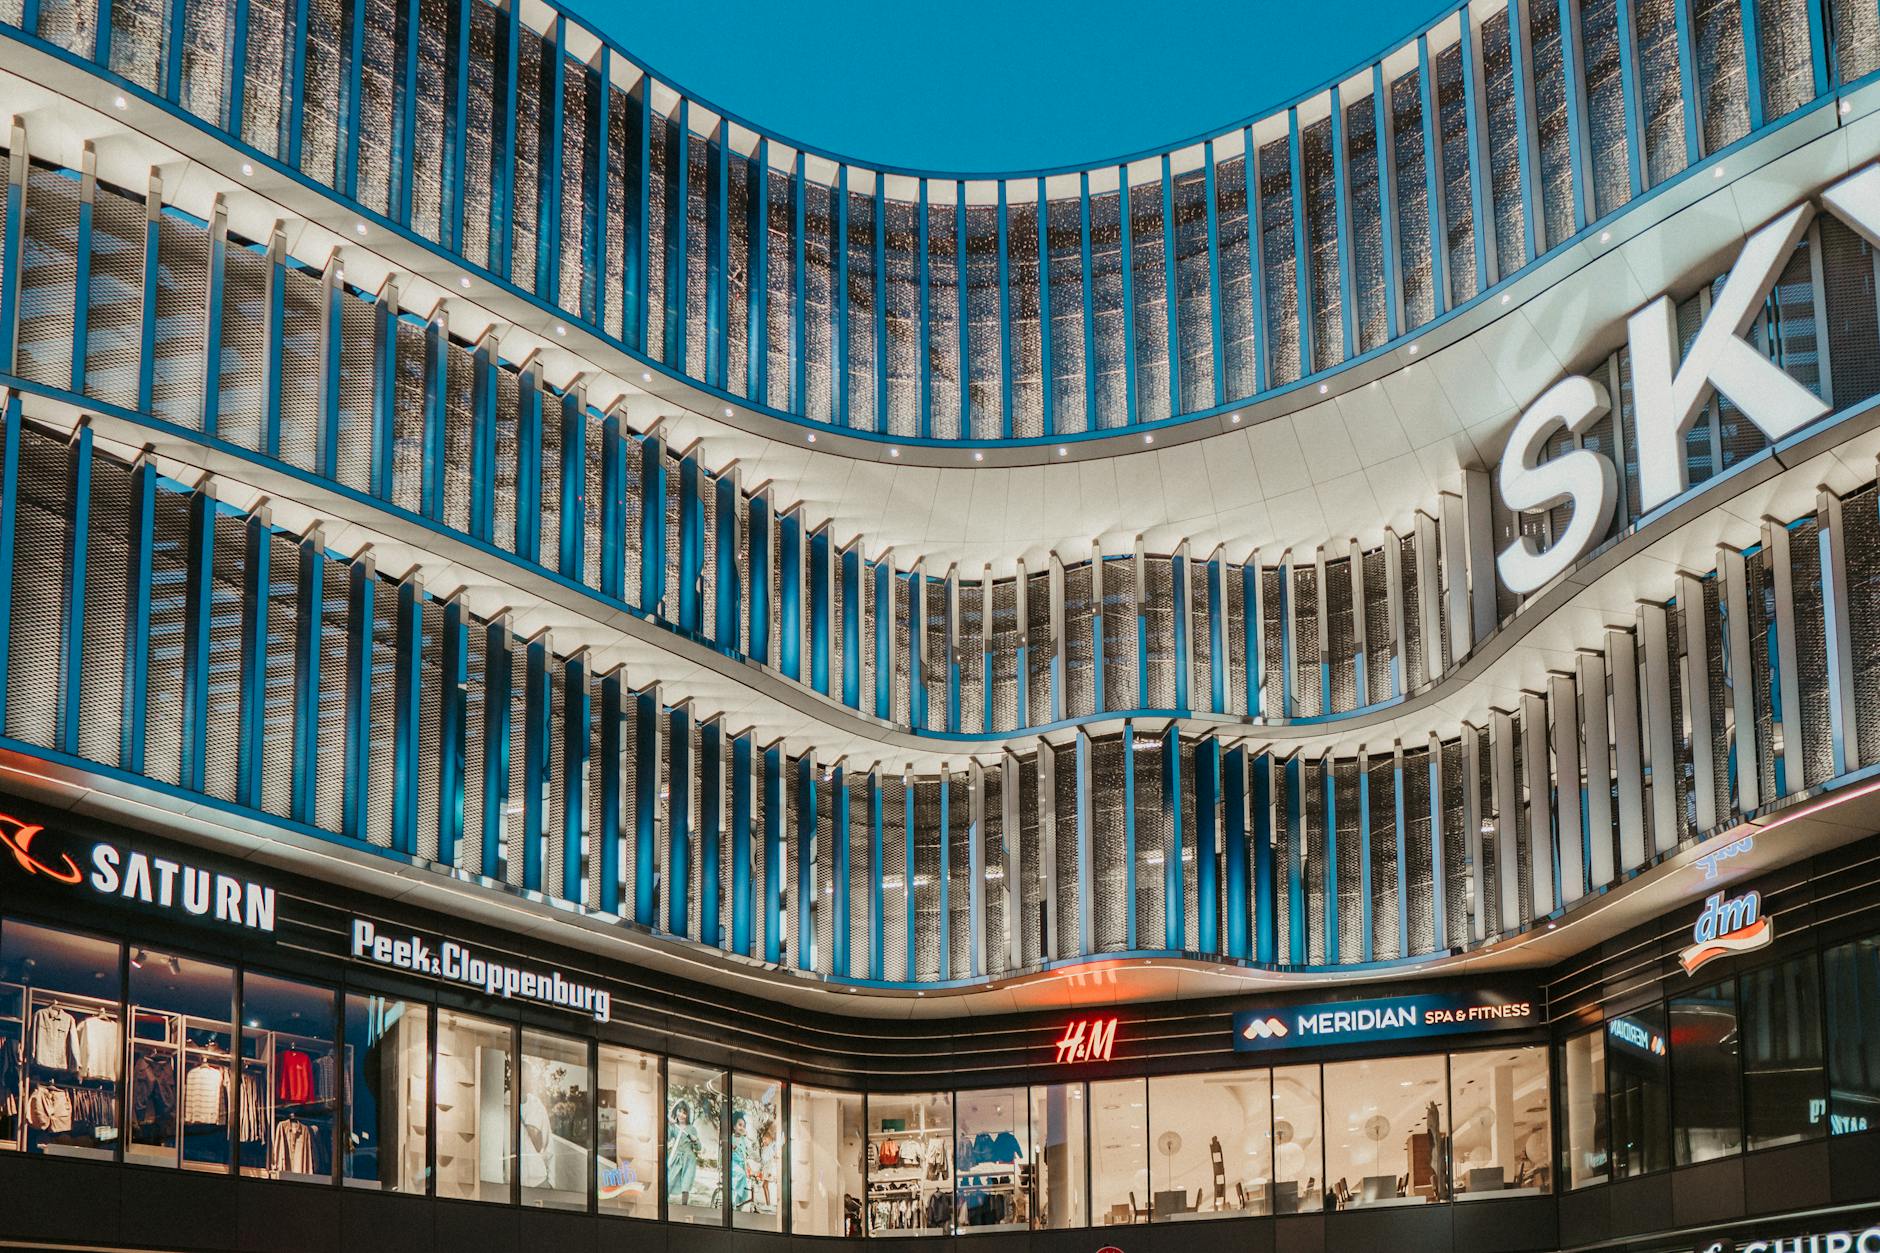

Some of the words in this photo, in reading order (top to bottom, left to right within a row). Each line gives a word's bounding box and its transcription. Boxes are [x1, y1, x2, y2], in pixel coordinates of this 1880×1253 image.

[90, 843, 276, 932] SATURN
[1694, 893, 1758, 945] dm
[1055, 1018, 1118, 1065] H&M
[1297, 1005, 1418, 1036] MERIDIAN
[1424, 1010, 1455, 1025] SPA
[1455, 1008, 1466, 1022] &
[1468, 1002, 1531, 1020] FITNESS
